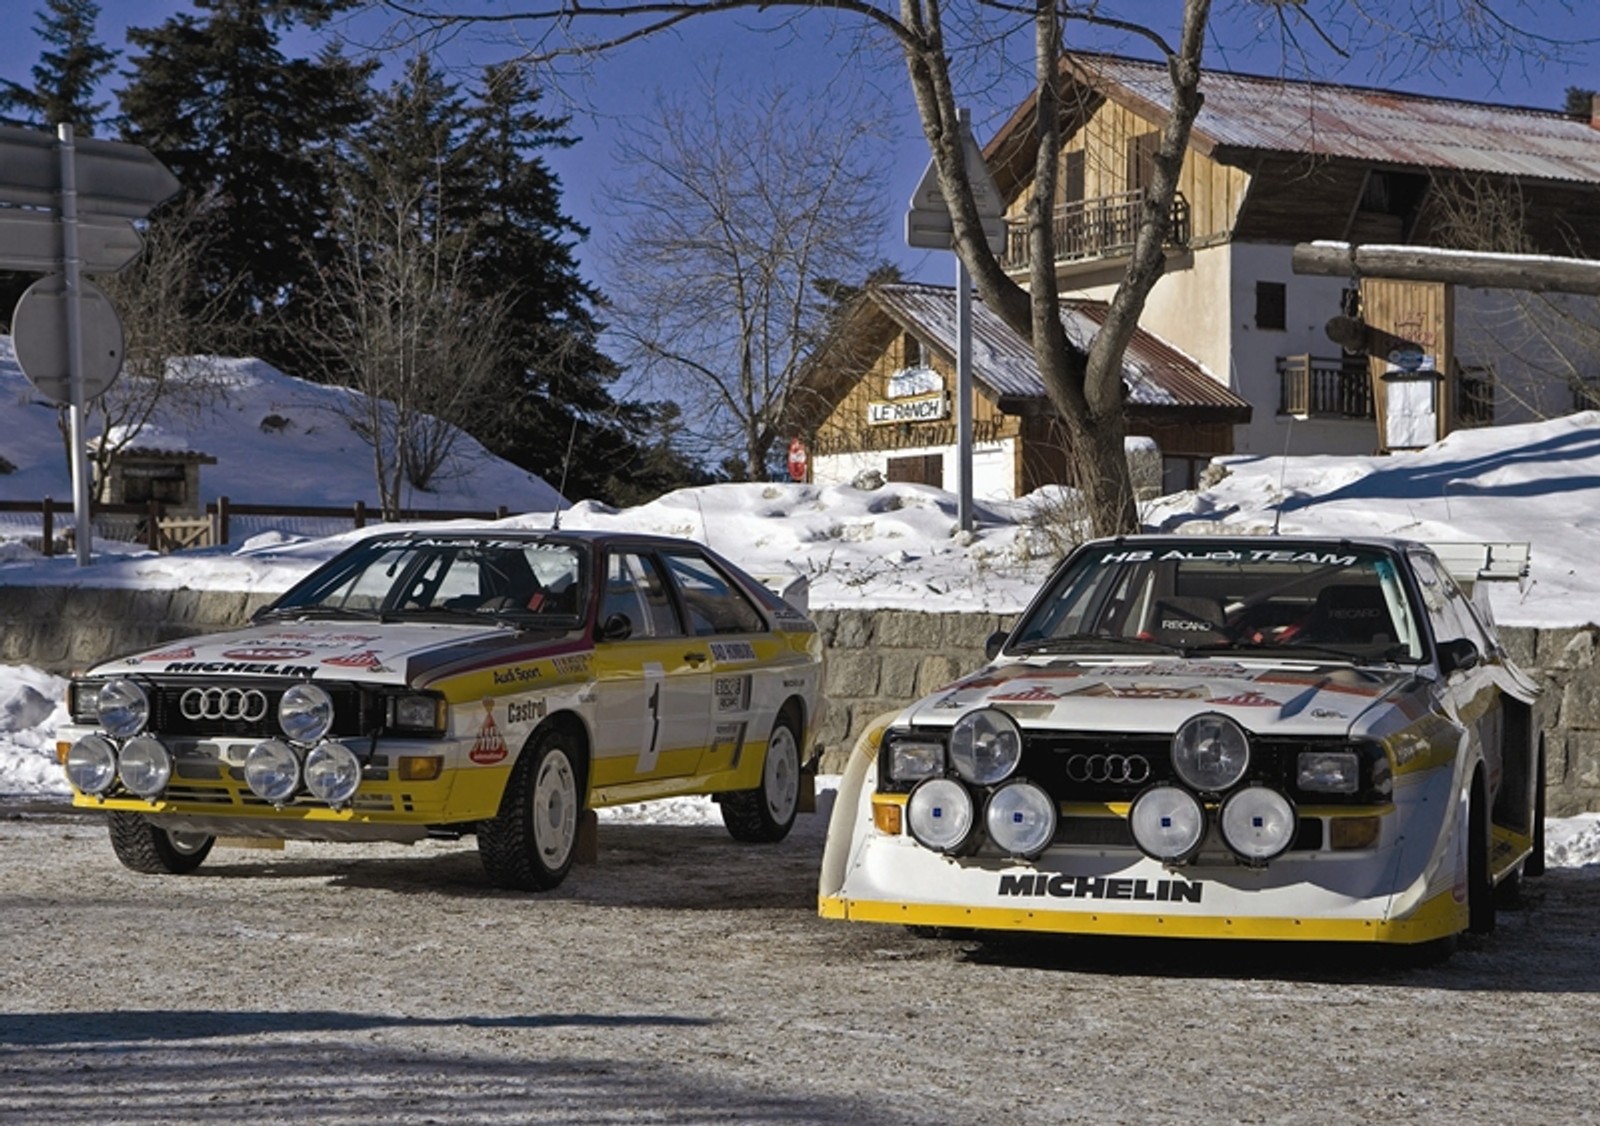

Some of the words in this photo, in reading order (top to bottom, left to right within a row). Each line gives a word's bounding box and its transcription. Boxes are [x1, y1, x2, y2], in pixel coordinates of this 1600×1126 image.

[873, 406, 890, 421] LE
[894, 400, 939, 420] RANCH
[1101, 551, 1153, 564] HB
[1250, 551, 1358, 566] TEAM
[164, 662, 318, 678] MICHELIN
[494, 670, 515, 684] Audi
[515, 667, 543, 683] Sport
[508, 697, 548, 723] Castrol
[648, 682, 660, 752] 1
[998, 874, 1204, 903] MICHELIN
